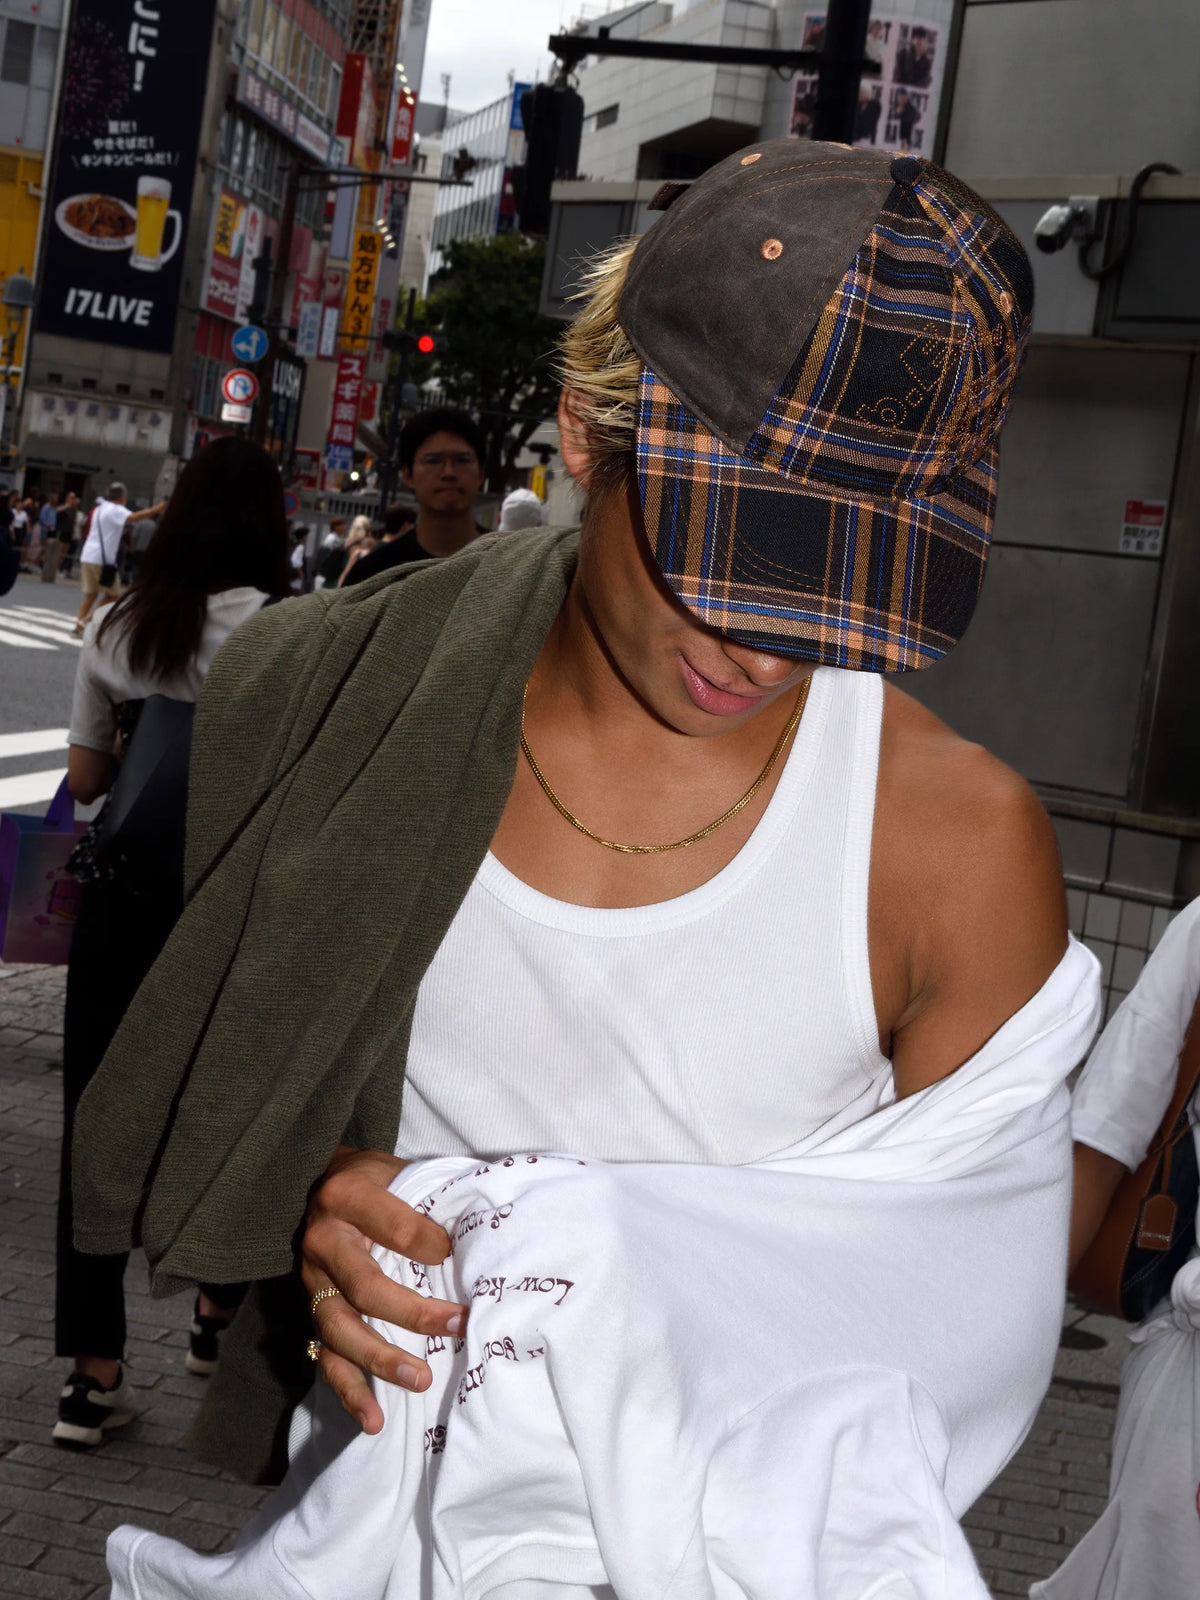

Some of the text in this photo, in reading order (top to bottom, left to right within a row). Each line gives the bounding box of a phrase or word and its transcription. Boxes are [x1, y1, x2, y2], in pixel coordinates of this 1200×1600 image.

[272, 358, 302, 401] LUSH
[332, 357, 361, 443] スギ薬局
